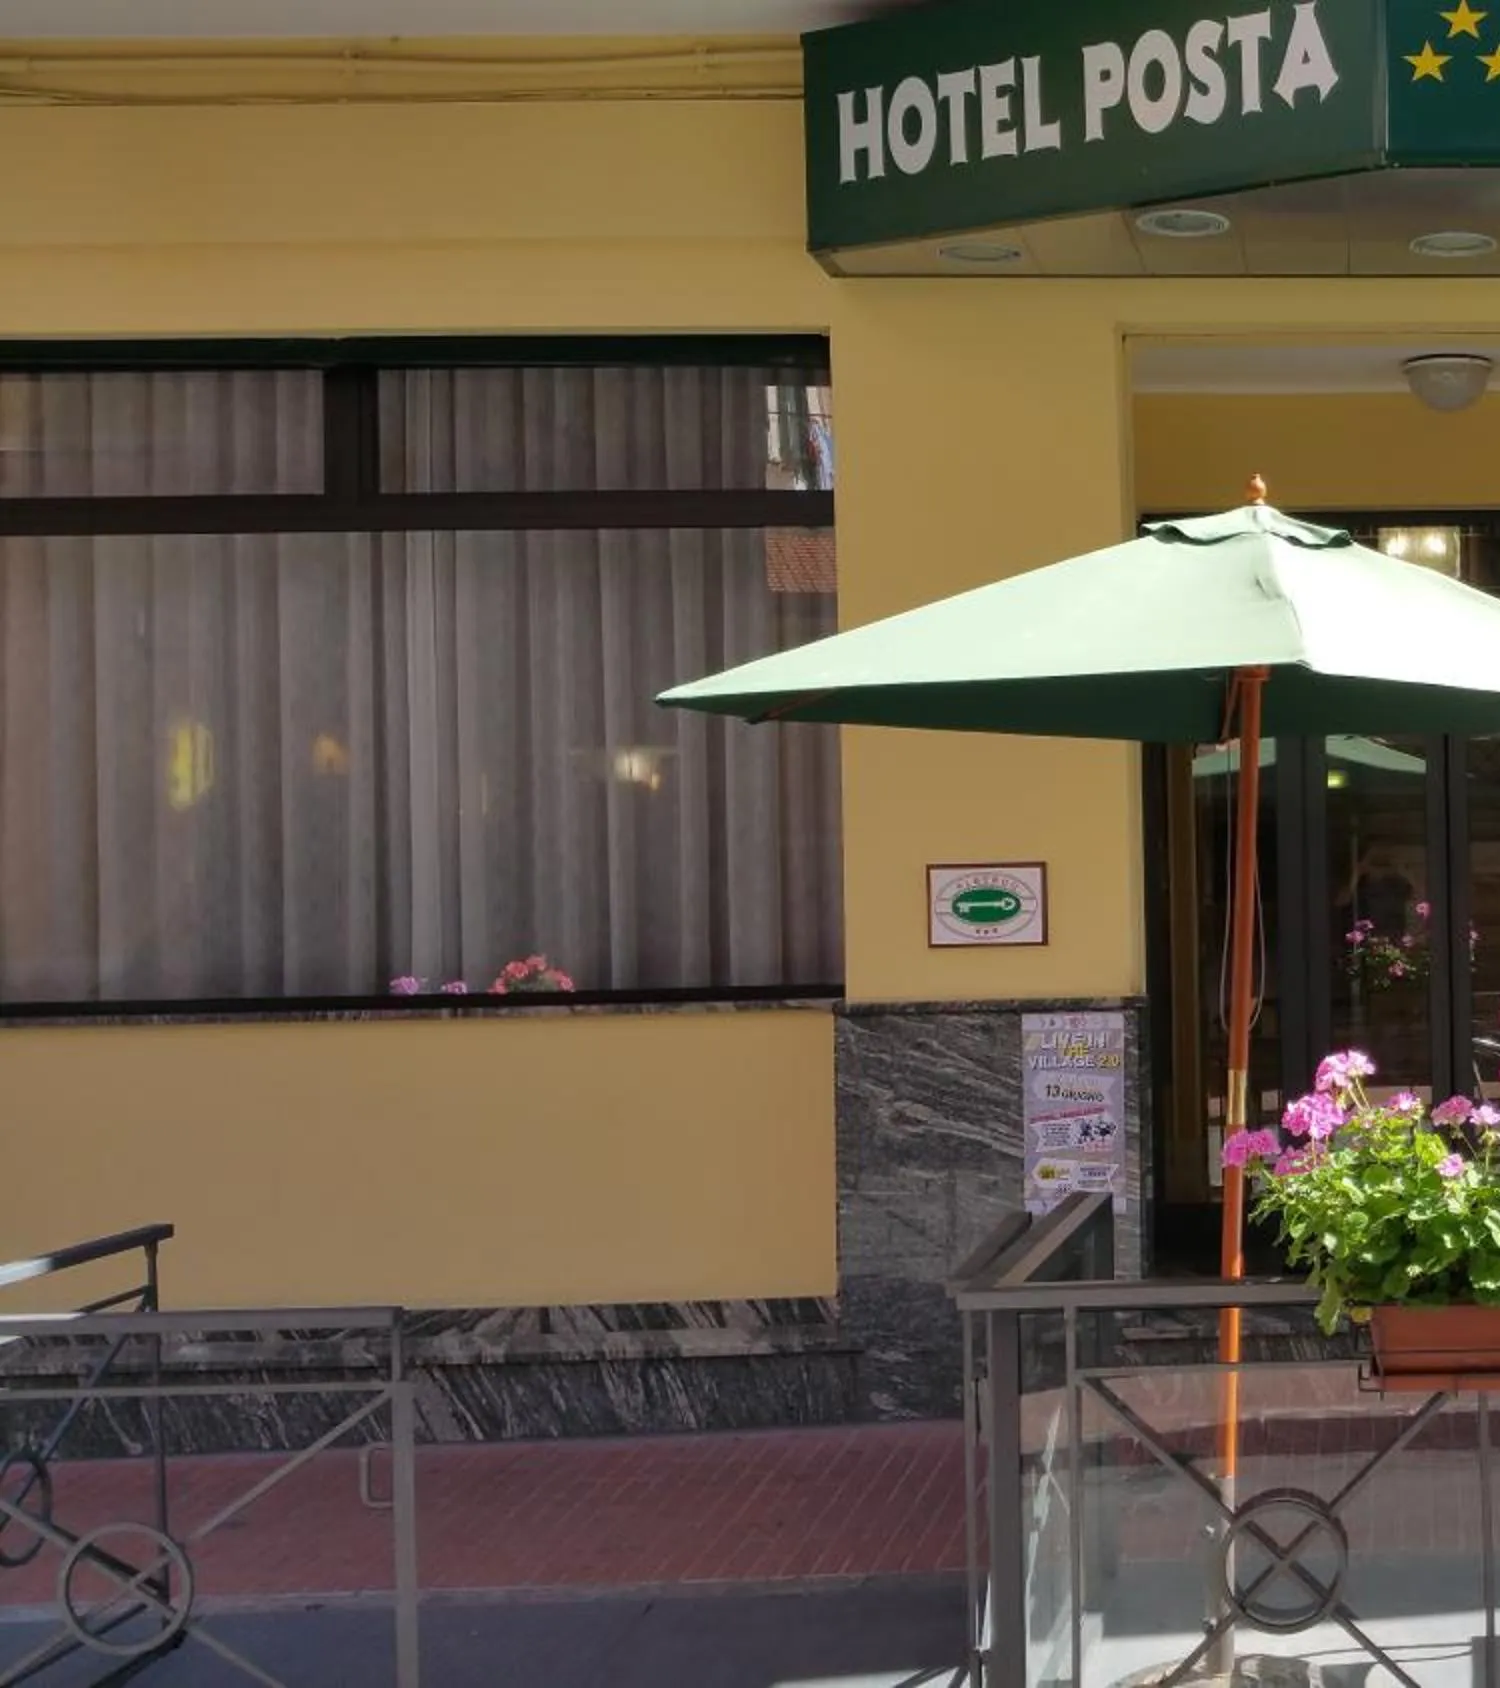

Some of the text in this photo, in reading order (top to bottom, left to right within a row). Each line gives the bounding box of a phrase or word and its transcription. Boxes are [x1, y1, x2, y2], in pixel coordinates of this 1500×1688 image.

[836, 0, 1340, 184] HOTEL POSTA
[1028, 1054, 1096, 1071] VILLAGE
[1046, 1084, 1060, 1098] 13
